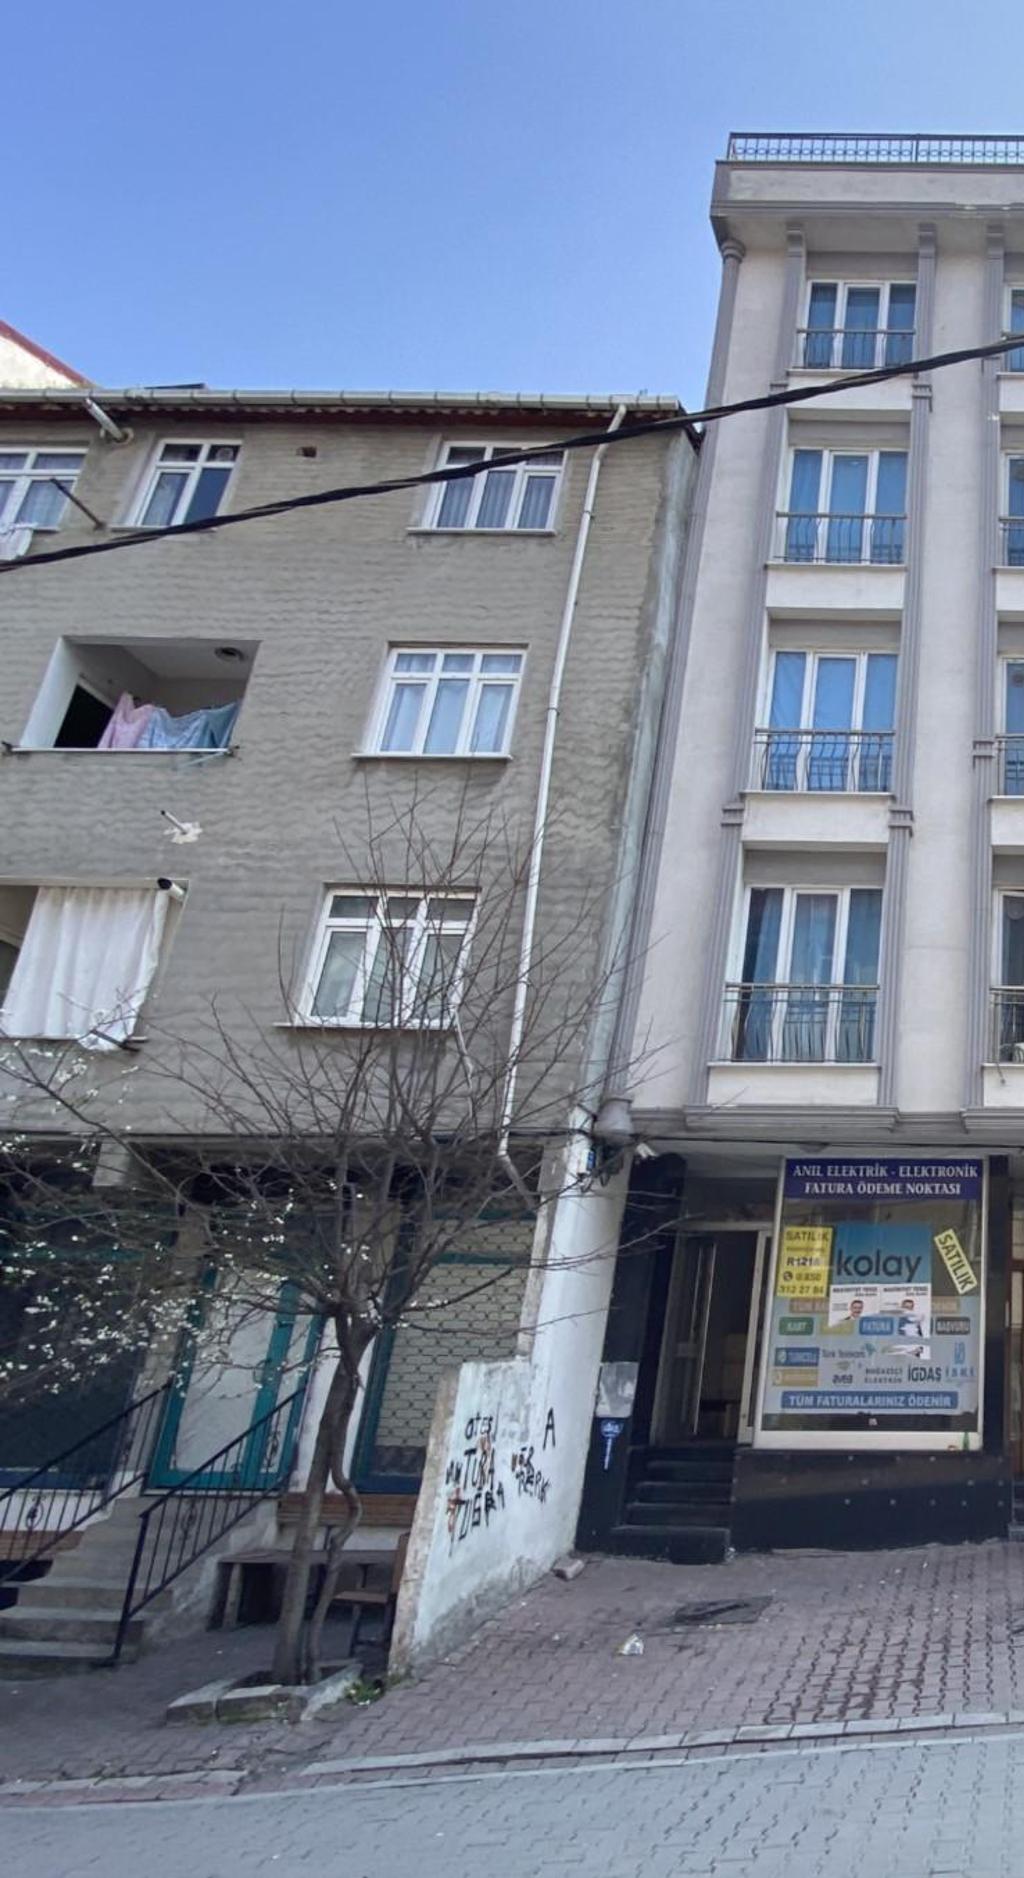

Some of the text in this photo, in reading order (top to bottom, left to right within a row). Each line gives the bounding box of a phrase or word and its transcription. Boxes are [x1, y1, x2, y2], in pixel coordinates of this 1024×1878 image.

[793, 1165, 823, 1177] ANIL
[826, 1163, 888, 1177] ELEKTRİK
[899, 1163, 978, 1178] ELEKTRONİK
[804, 1181, 961, 1195] FATURA ÖDEME NOKTASI
[836, 1249, 922, 1282] kolay
[938, 1233, 975, 1291] SATILIK
